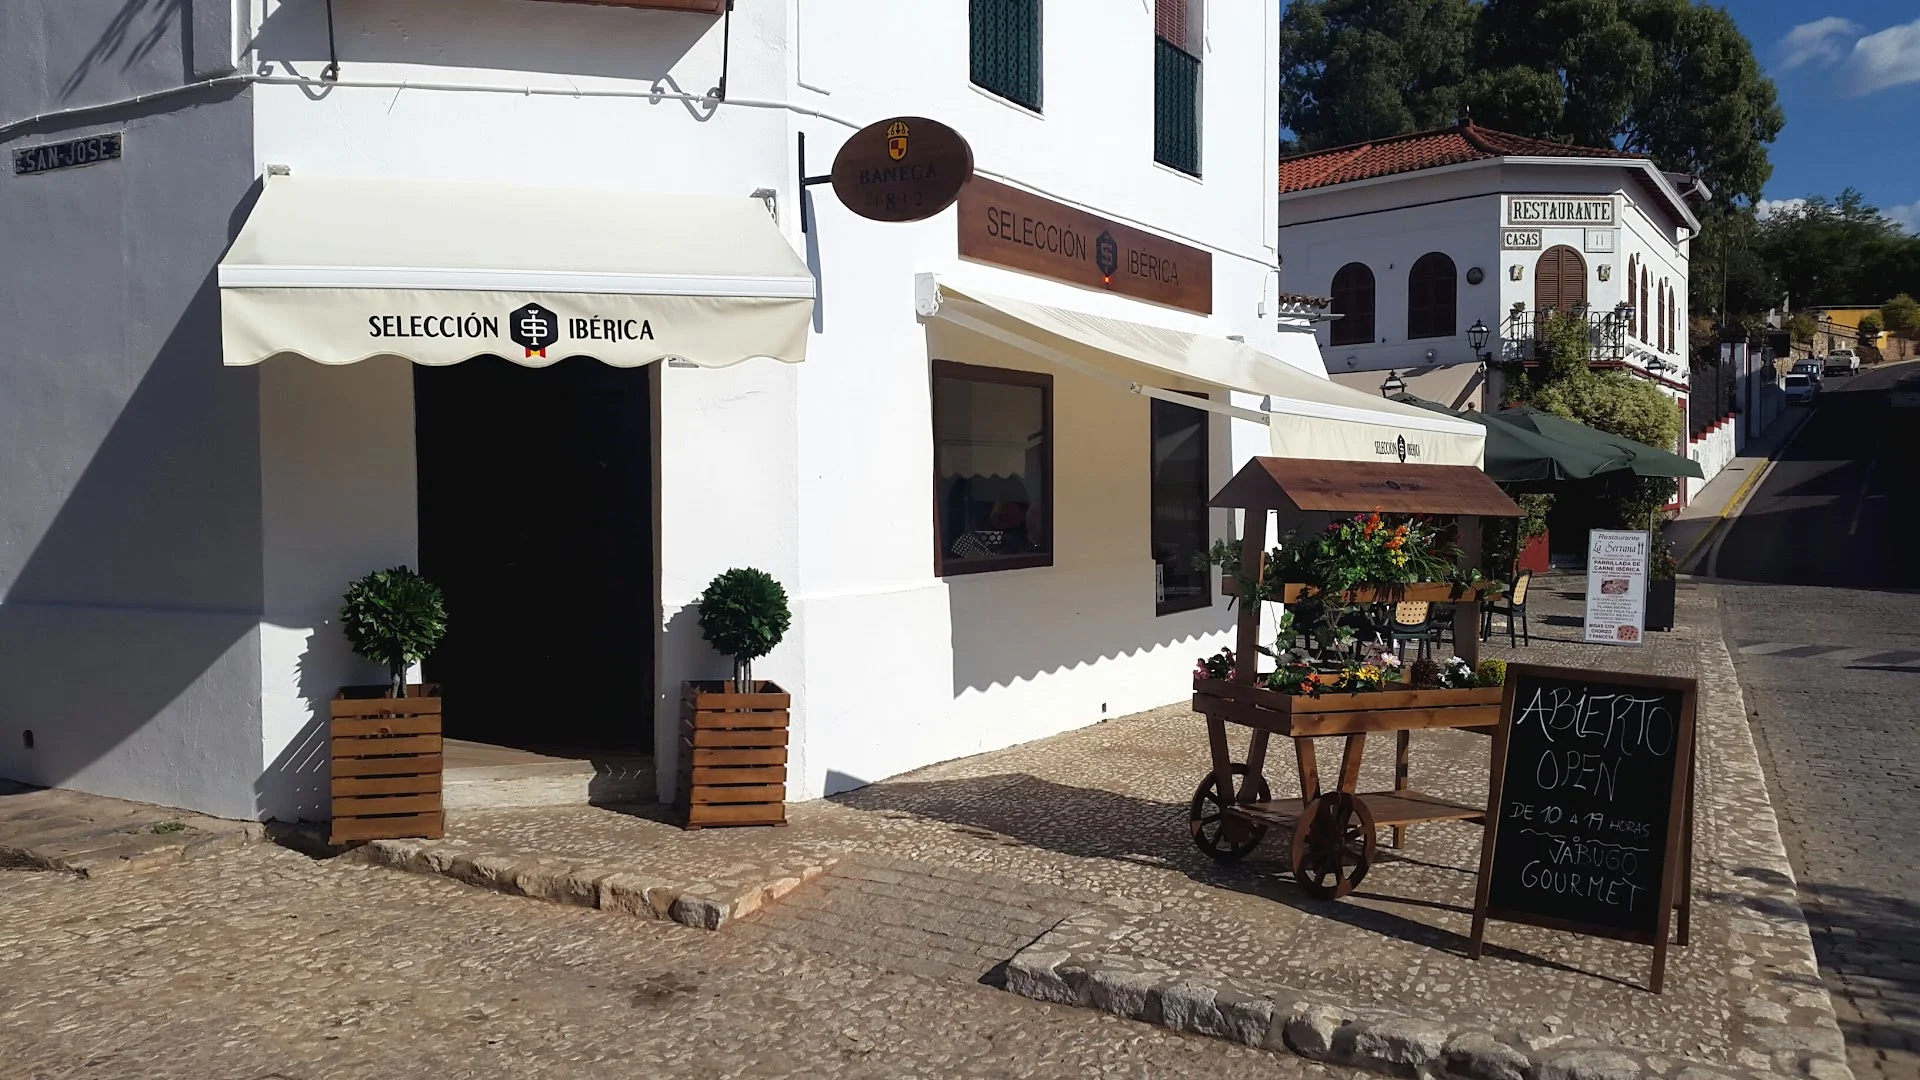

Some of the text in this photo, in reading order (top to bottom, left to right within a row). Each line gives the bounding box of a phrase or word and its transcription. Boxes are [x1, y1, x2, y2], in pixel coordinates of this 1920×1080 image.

[1513, 201, 1610, 220] RESTAURANTE
[987, 206, 1179, 286] SELECCIÓN IBÉRICA
[1506, 233, 1538, 246] CASAS
[368, 312, 655, 343] SELECCIÓN IBÉRICA
[1593, 541, 1636, 554] La Serrana
[1536, 750, 1622, 802] OPEN
[1510, 802, 1535, 820] DE
[1540, 806, 1563, 823] 10
[1583, 813, 1604, 831] 19
[1609, 819, 1651, 839] HORAS
[1550, 839, 1638, 876] JABUGO
[1521, 860, 1648, 912] GOURMET
